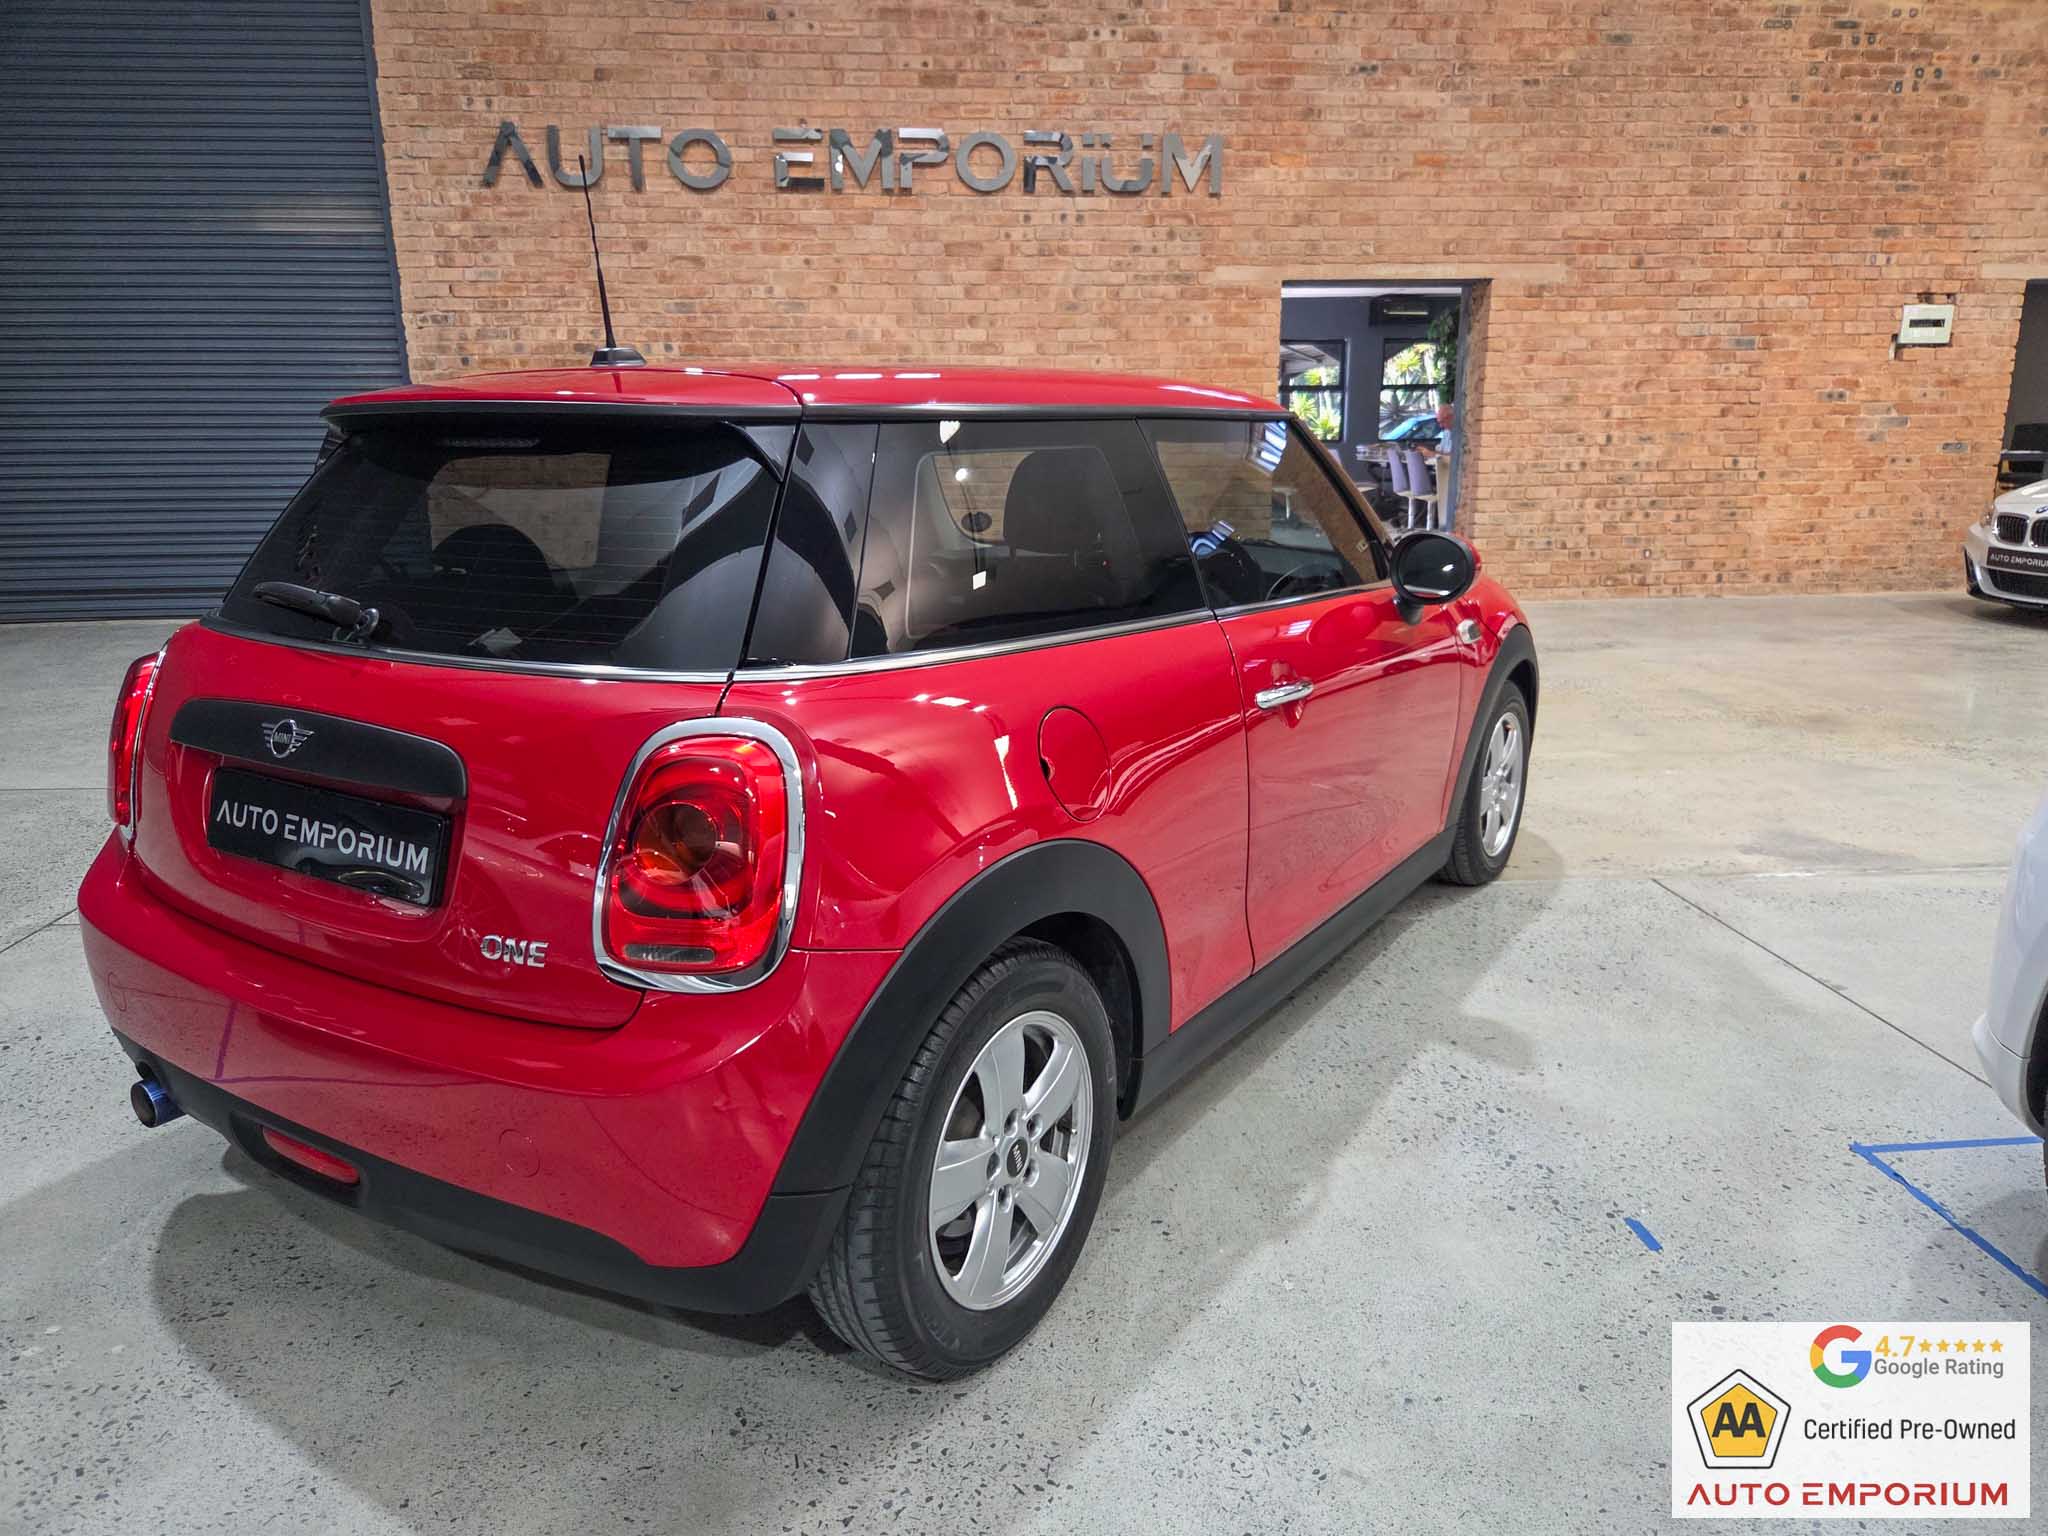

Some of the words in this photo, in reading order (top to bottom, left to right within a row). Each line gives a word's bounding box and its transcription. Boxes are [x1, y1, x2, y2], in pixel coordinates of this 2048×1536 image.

[481, 121, 732, 192] AUTO
[774, 126, 1225, 197] EMPORIUM
[1990, 553, 2010, 562] AUTO
[2010, 556, 2048, 568] EMPORIU
[216, 799, 279, 836] AUTO
[283, 812, 429, 875] EMPORIUM
[479, 934, 549, 968] ONE
[1012, 1143, 1024, 1173] MINI
